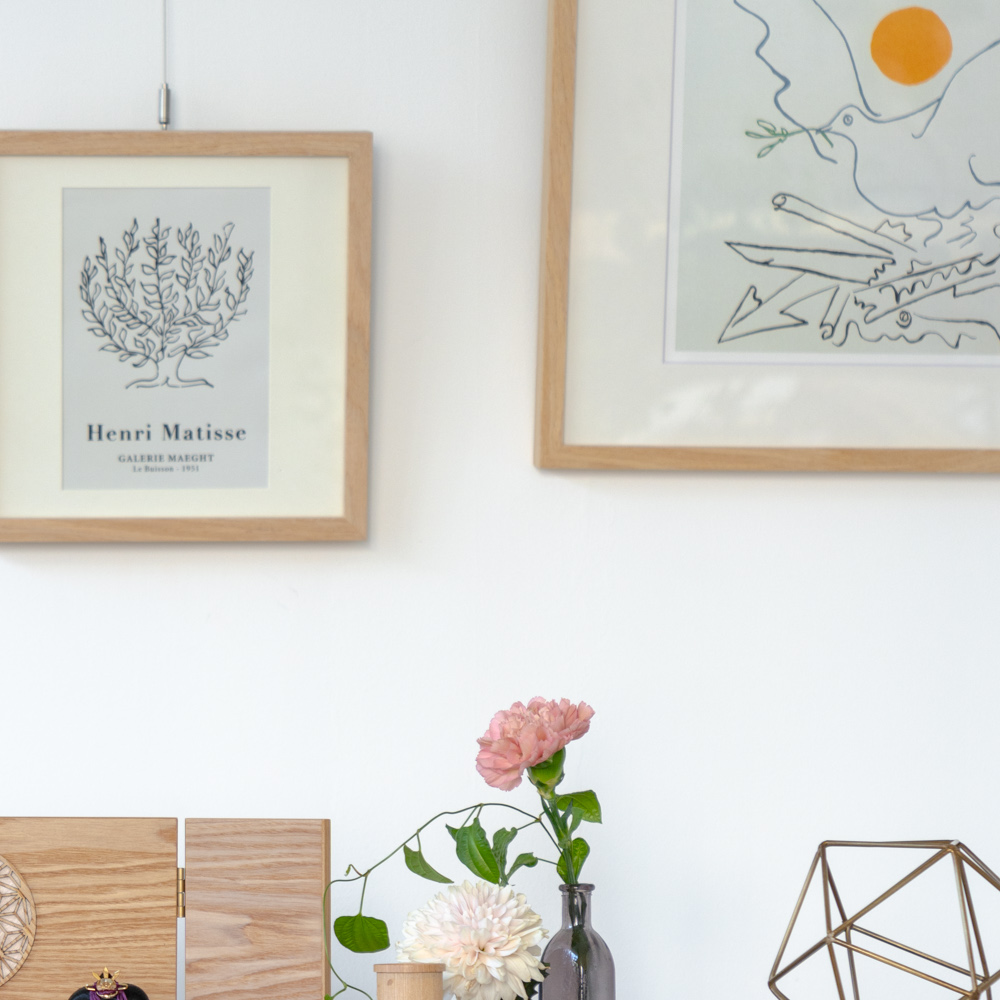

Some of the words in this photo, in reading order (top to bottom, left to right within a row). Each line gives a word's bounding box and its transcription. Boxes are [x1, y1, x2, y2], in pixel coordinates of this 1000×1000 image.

[87, 424, 152, 441] Henri
[162, 424, 247, 441] Matisse
[118, 454, 165, 462] GALERIE
[168, 454, 214, 462] MAEGHT
